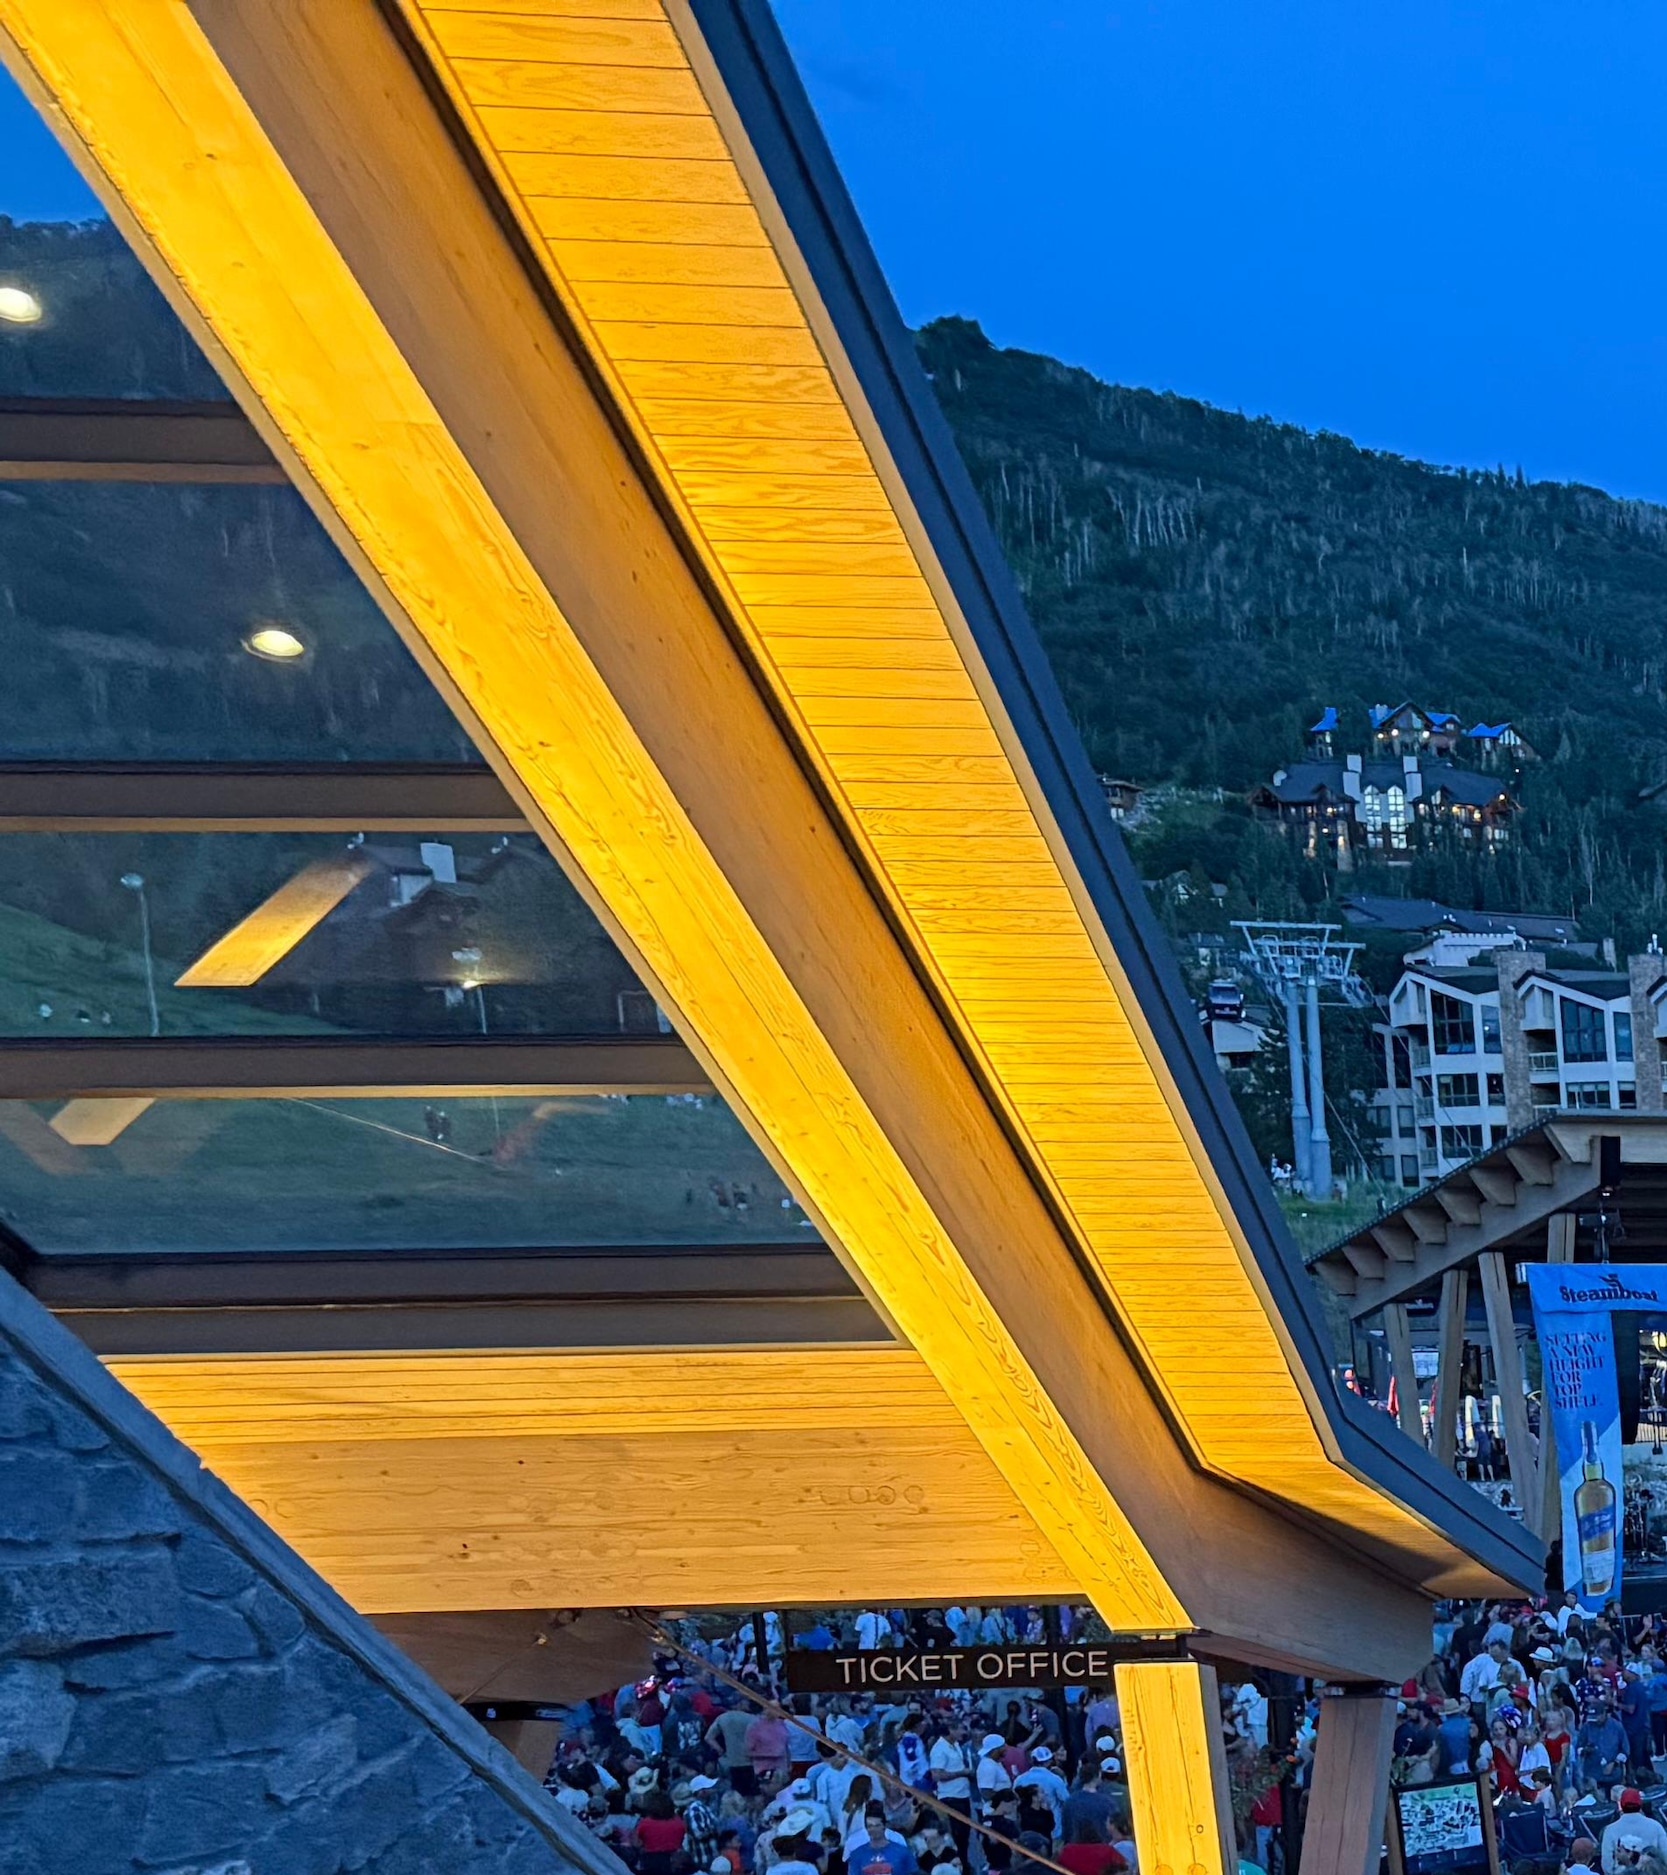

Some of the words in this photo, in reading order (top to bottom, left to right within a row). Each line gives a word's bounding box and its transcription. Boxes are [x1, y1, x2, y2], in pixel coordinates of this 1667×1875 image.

[1559, 1276, 1658, 1303] Steamboat
[1554, 1383, 1582, 1397] TOP
[835, 1654, 964, 1685] TICKET
[976, 1650, 1109, 1680] OFFICE
